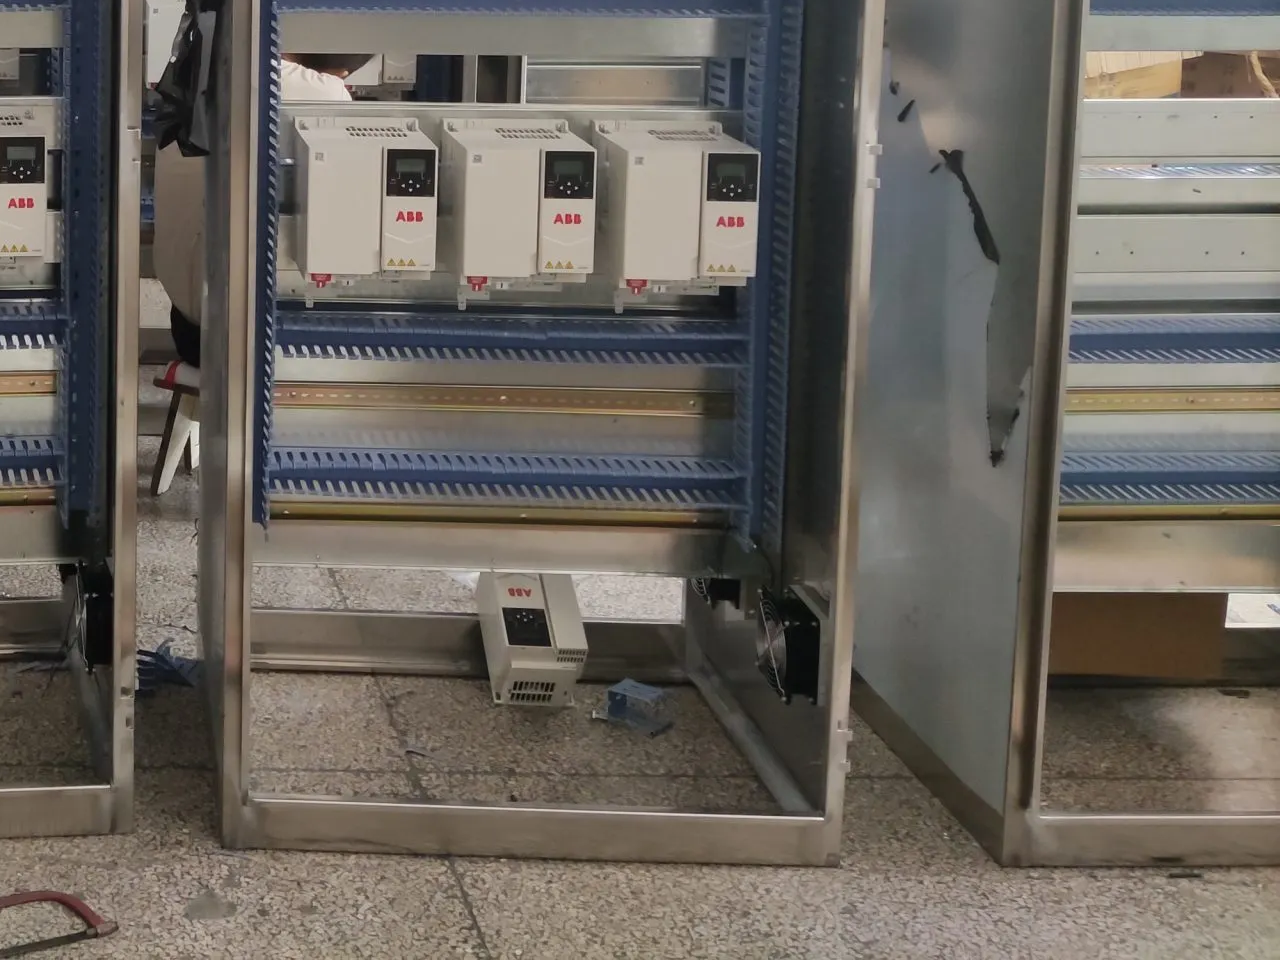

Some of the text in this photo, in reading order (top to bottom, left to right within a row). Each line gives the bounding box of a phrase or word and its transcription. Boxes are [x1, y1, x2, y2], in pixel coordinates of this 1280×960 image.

[8, 197, 35, 209] ABB
[396, 211, 424, 222] ABB
[554, 213, 582, 225] ABB
[716, 216, 745, 228] ABB
[507, 587, 532, 597] ABB
